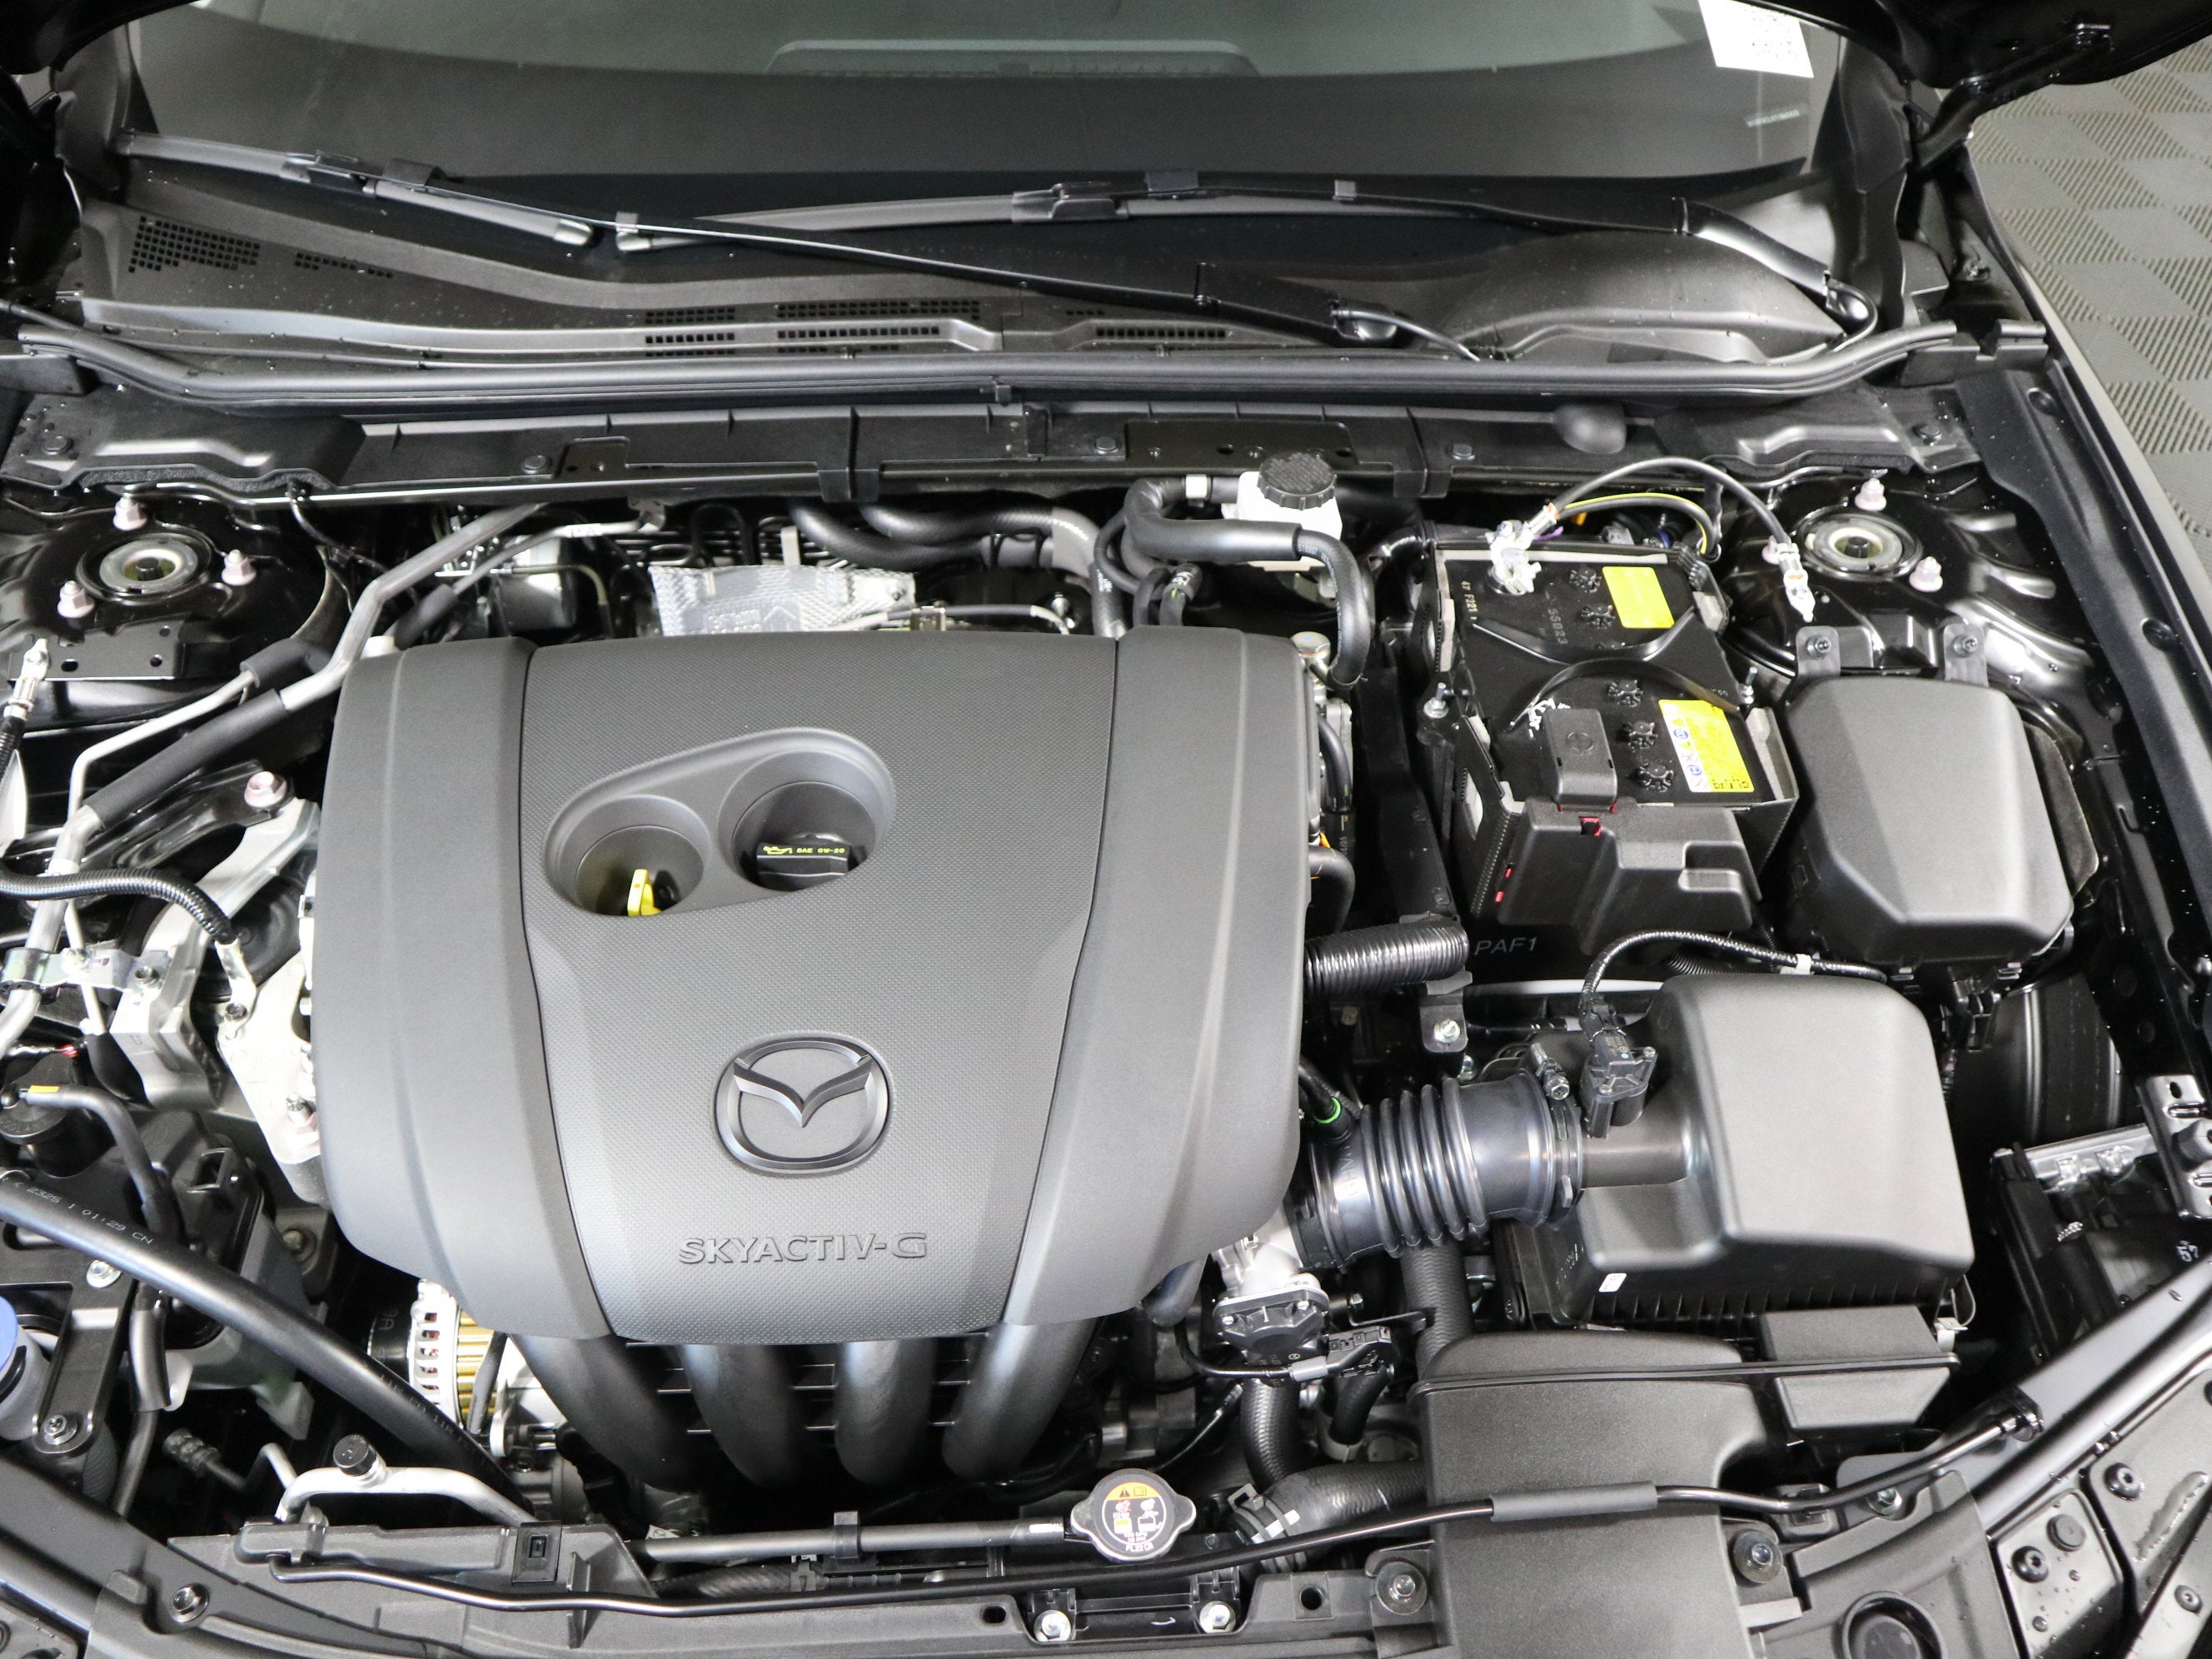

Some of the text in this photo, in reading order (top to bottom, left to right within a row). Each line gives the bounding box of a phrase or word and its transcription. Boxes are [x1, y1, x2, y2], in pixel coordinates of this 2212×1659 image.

[1473, 937, 1538, 956] PAF1
[27, 1186, 62, 1204] 2325
[132, 1232, 154, 1246] CN
[678, 1231, 928, 1265] SKYACTIV-G
